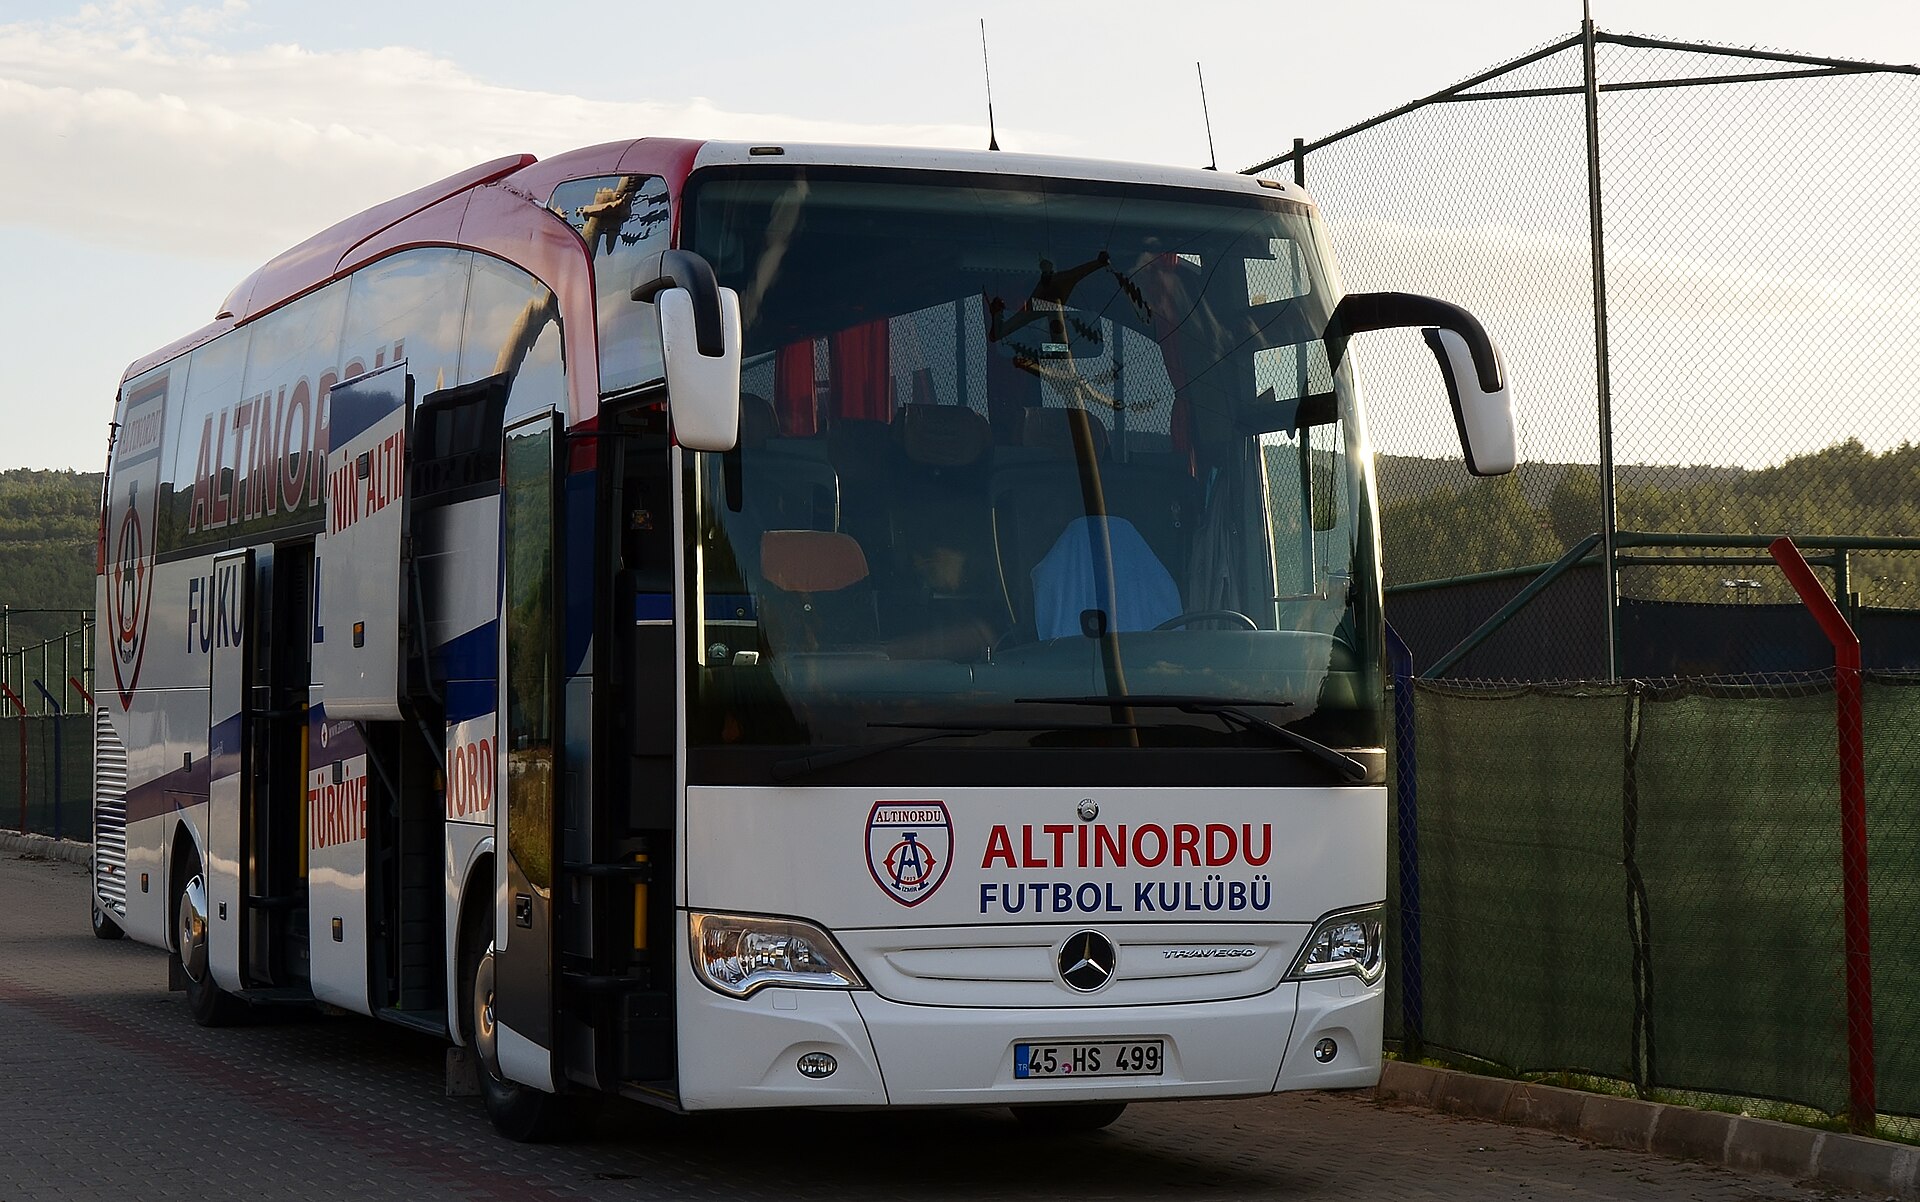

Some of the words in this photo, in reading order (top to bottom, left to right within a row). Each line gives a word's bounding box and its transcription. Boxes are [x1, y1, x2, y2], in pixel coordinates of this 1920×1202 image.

[308, 765, 366, 850] TÜRKİYE
[876, 810, 941, 822] ALTINORDU
[981, 823, 1272, 868] ALTINORDU
[979, 881, 1122, 914] FUTBOL
[1134, 874, 1271, 912] KULÜBÜ
[1163, 948, 1256, 959] TRAVEGO
[1018, 1063, 1028, 1071] TR
[1029, 1048, 1057, 1073] 45
[1073, 1047, 1101, 1071] HS
[1116, 1046, 1158, 1070] 499
